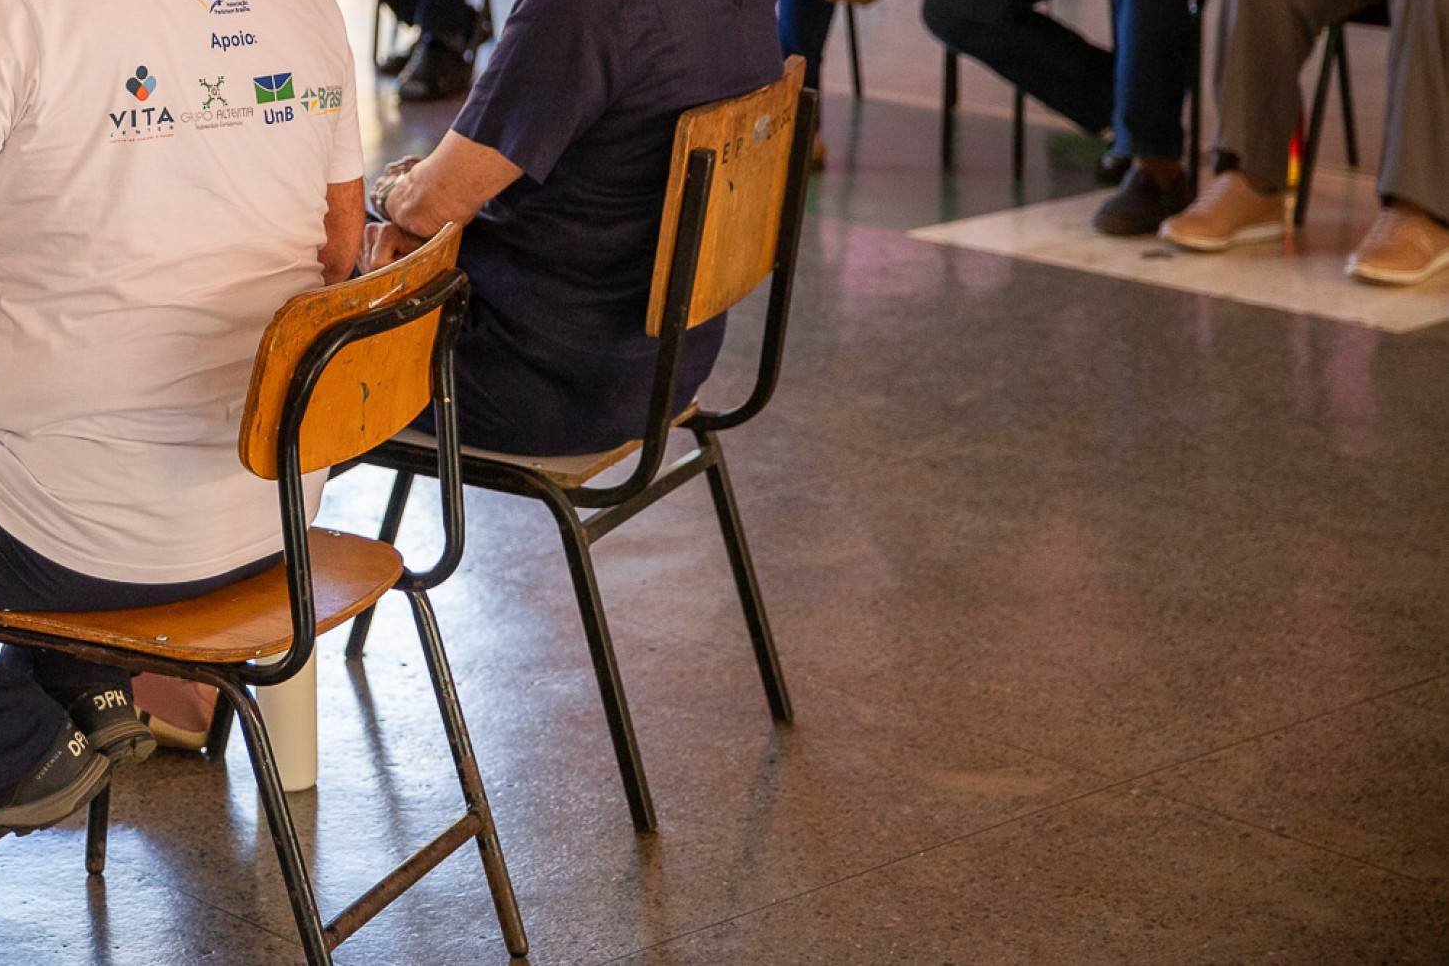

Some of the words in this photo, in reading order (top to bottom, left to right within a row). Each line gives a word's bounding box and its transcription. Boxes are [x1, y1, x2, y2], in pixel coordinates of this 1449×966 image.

[210, 30, 258, 52] Apoio:
[109, 106, 174, 129] VITA
[264, 106, 294, 124] UnB
